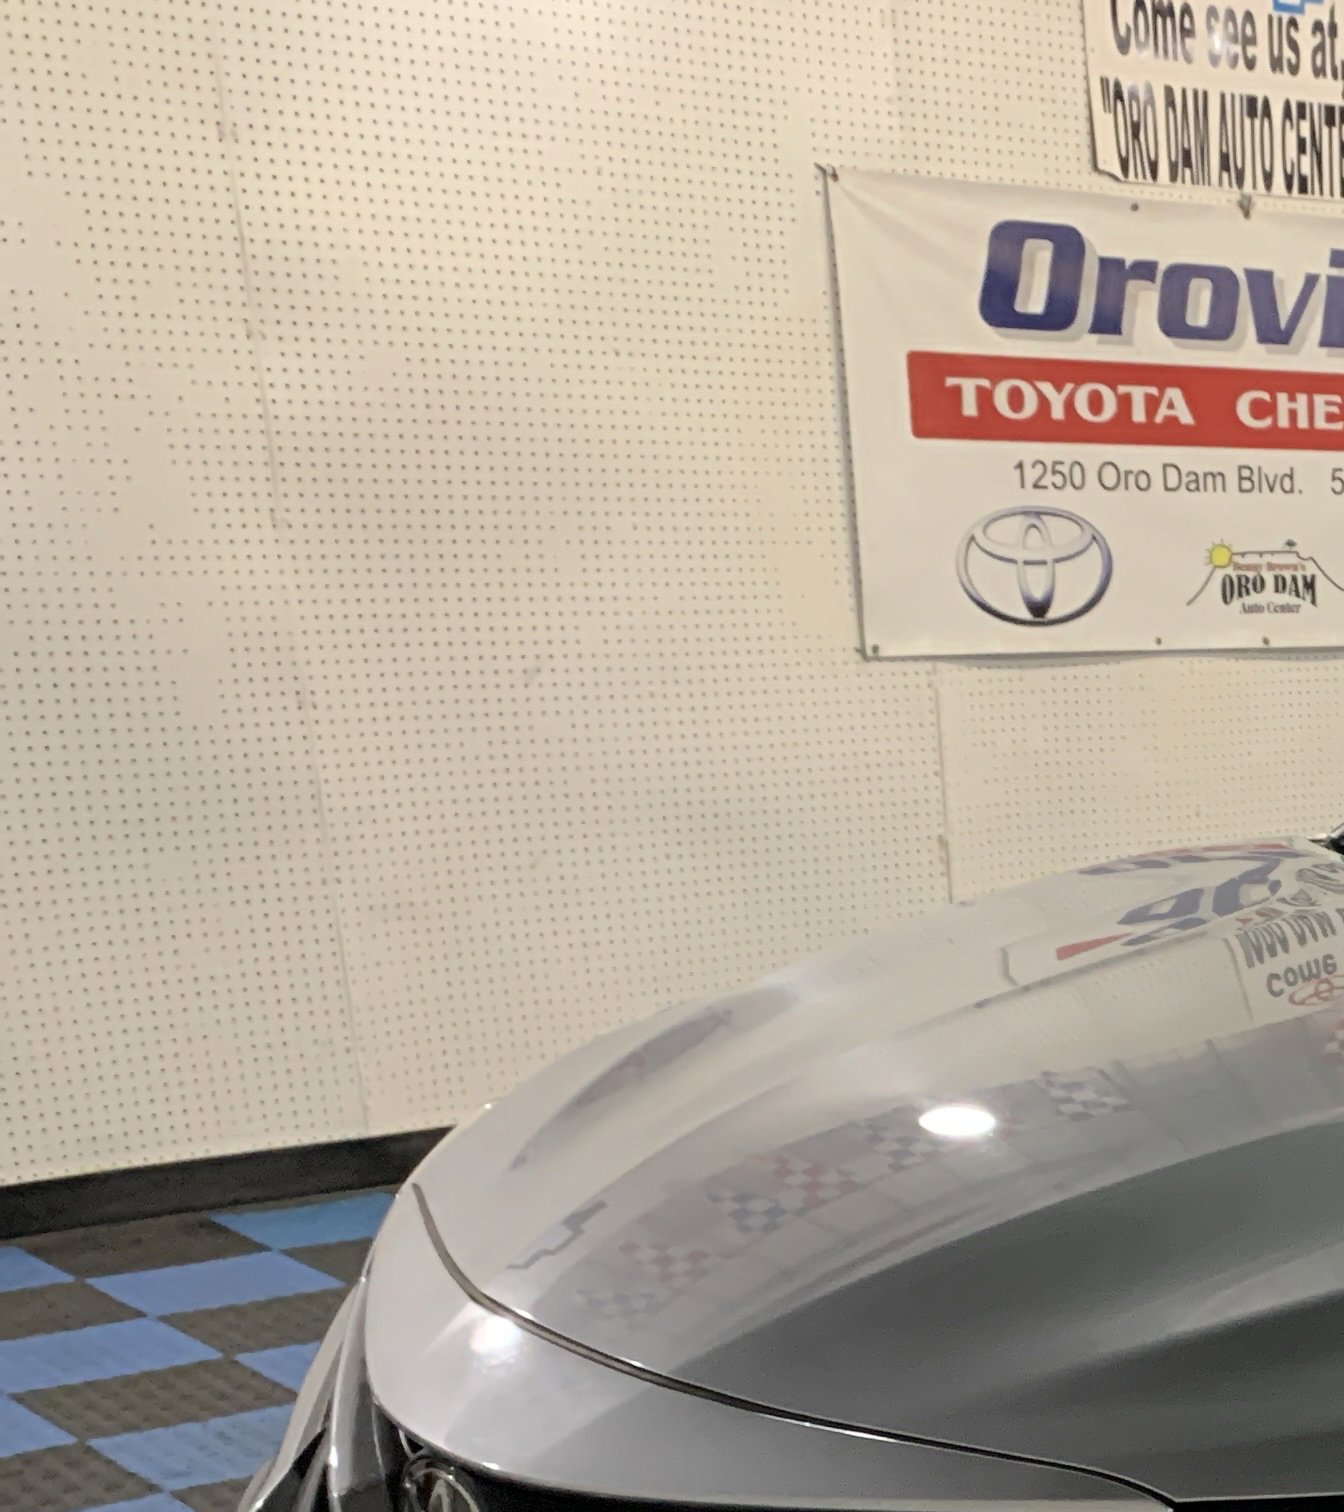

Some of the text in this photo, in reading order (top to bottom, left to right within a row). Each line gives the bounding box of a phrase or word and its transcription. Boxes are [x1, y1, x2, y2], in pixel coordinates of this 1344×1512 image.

[1110, 0, 1196, 64] Come
[1205, 4, 1257, 71] see
[1267, 12, 1301, 76] us
[1164, 84, 1211, 187] DAM
[1218, 90, 1275, 194] AUTO
[945, 374, 1196, 427] TOYOTA
[1012, 459, 1086, 492] 1250
[1098, 461, 1152, 493] Oro
[1163, 463, 1227, 494] Dam
[1237, 465, 1303, 496] Blvd.
[1221, 573, 1318, 608] ORO DAM
